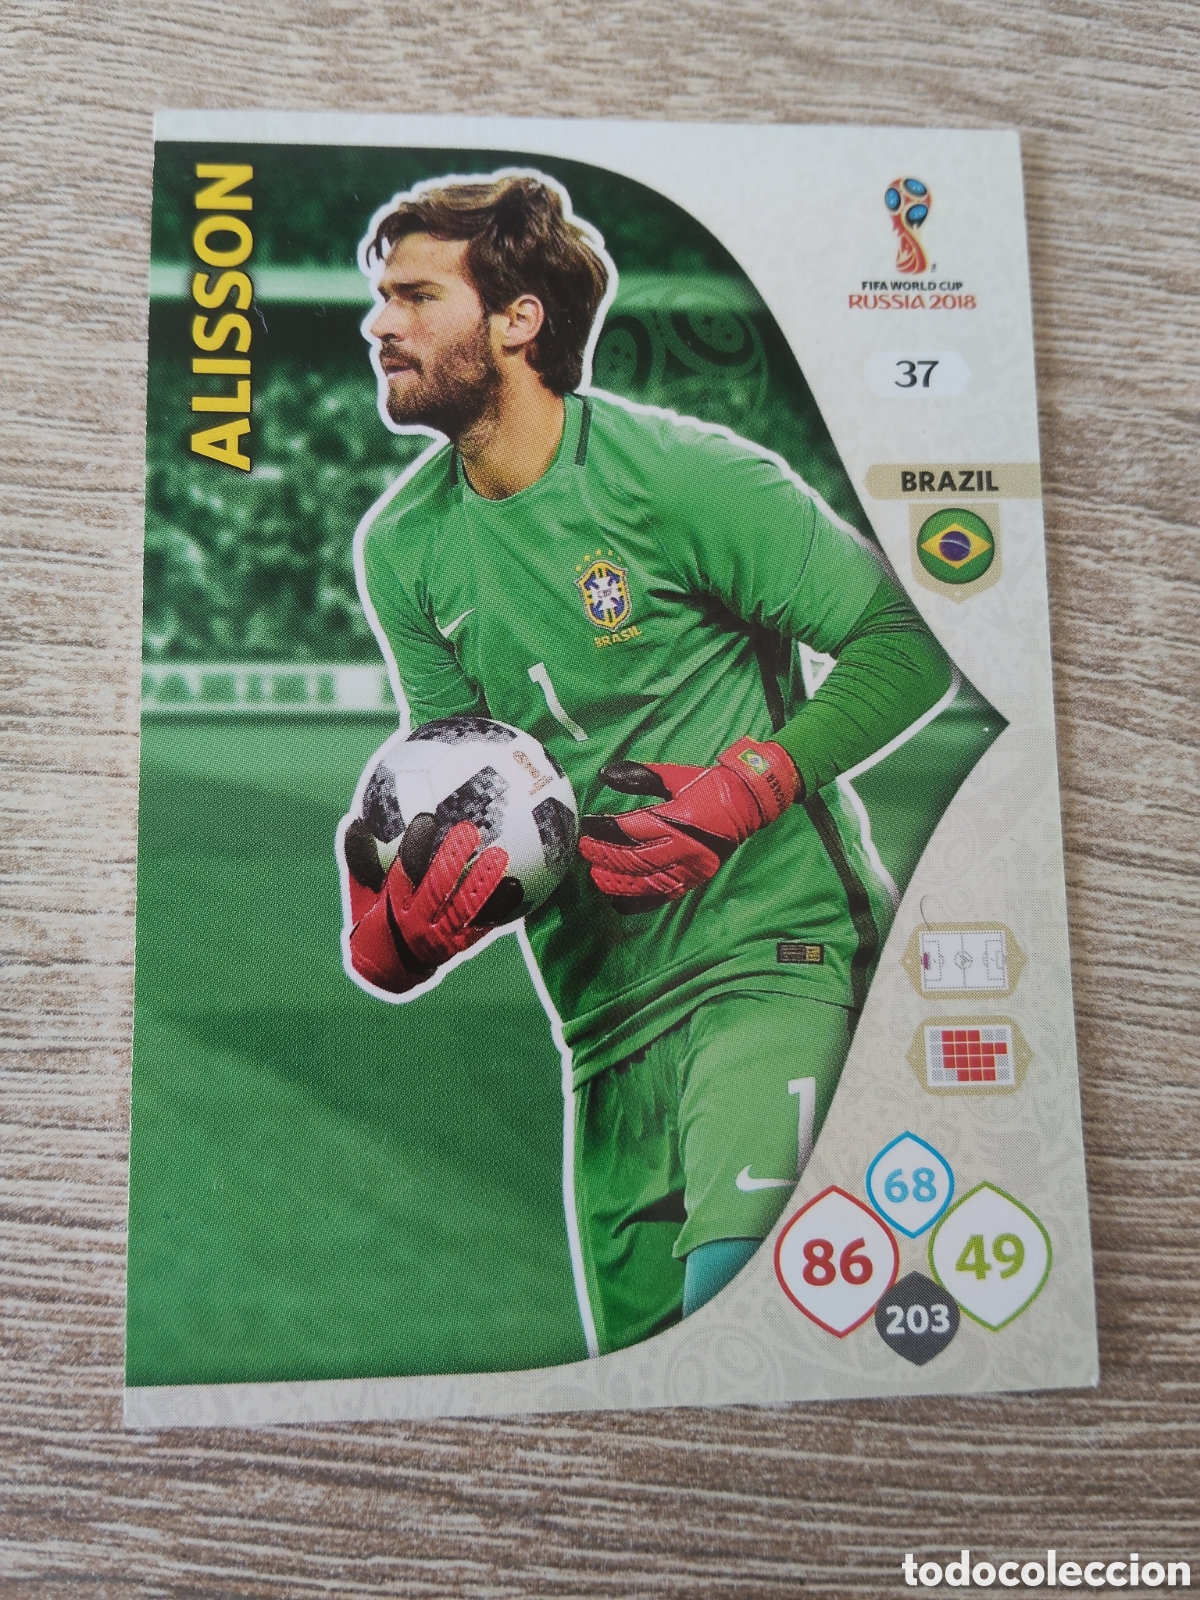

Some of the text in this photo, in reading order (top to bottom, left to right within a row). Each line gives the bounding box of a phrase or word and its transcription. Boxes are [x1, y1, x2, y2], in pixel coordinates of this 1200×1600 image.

[848, 294, 977, 310] RUSSIA 2018
[861, 281, 963, 291] FIFA WORLD CUP
[191, 163, 253, 472] ALISSON
[894, 360, 939, 388] 37
[900, 470, 999, 492] BRAZIL
[594, 625, 642, 648] BRASIL
[528, 662, 590, 742] 1
[787, 1076, 816, 1176] 1
[884, 1167, 937, 1203] 68
[802, 1237, 873, 1286] 86
[955, 1232, 1025, 1280] 49
[886, 1303, 950, 1335] 203
